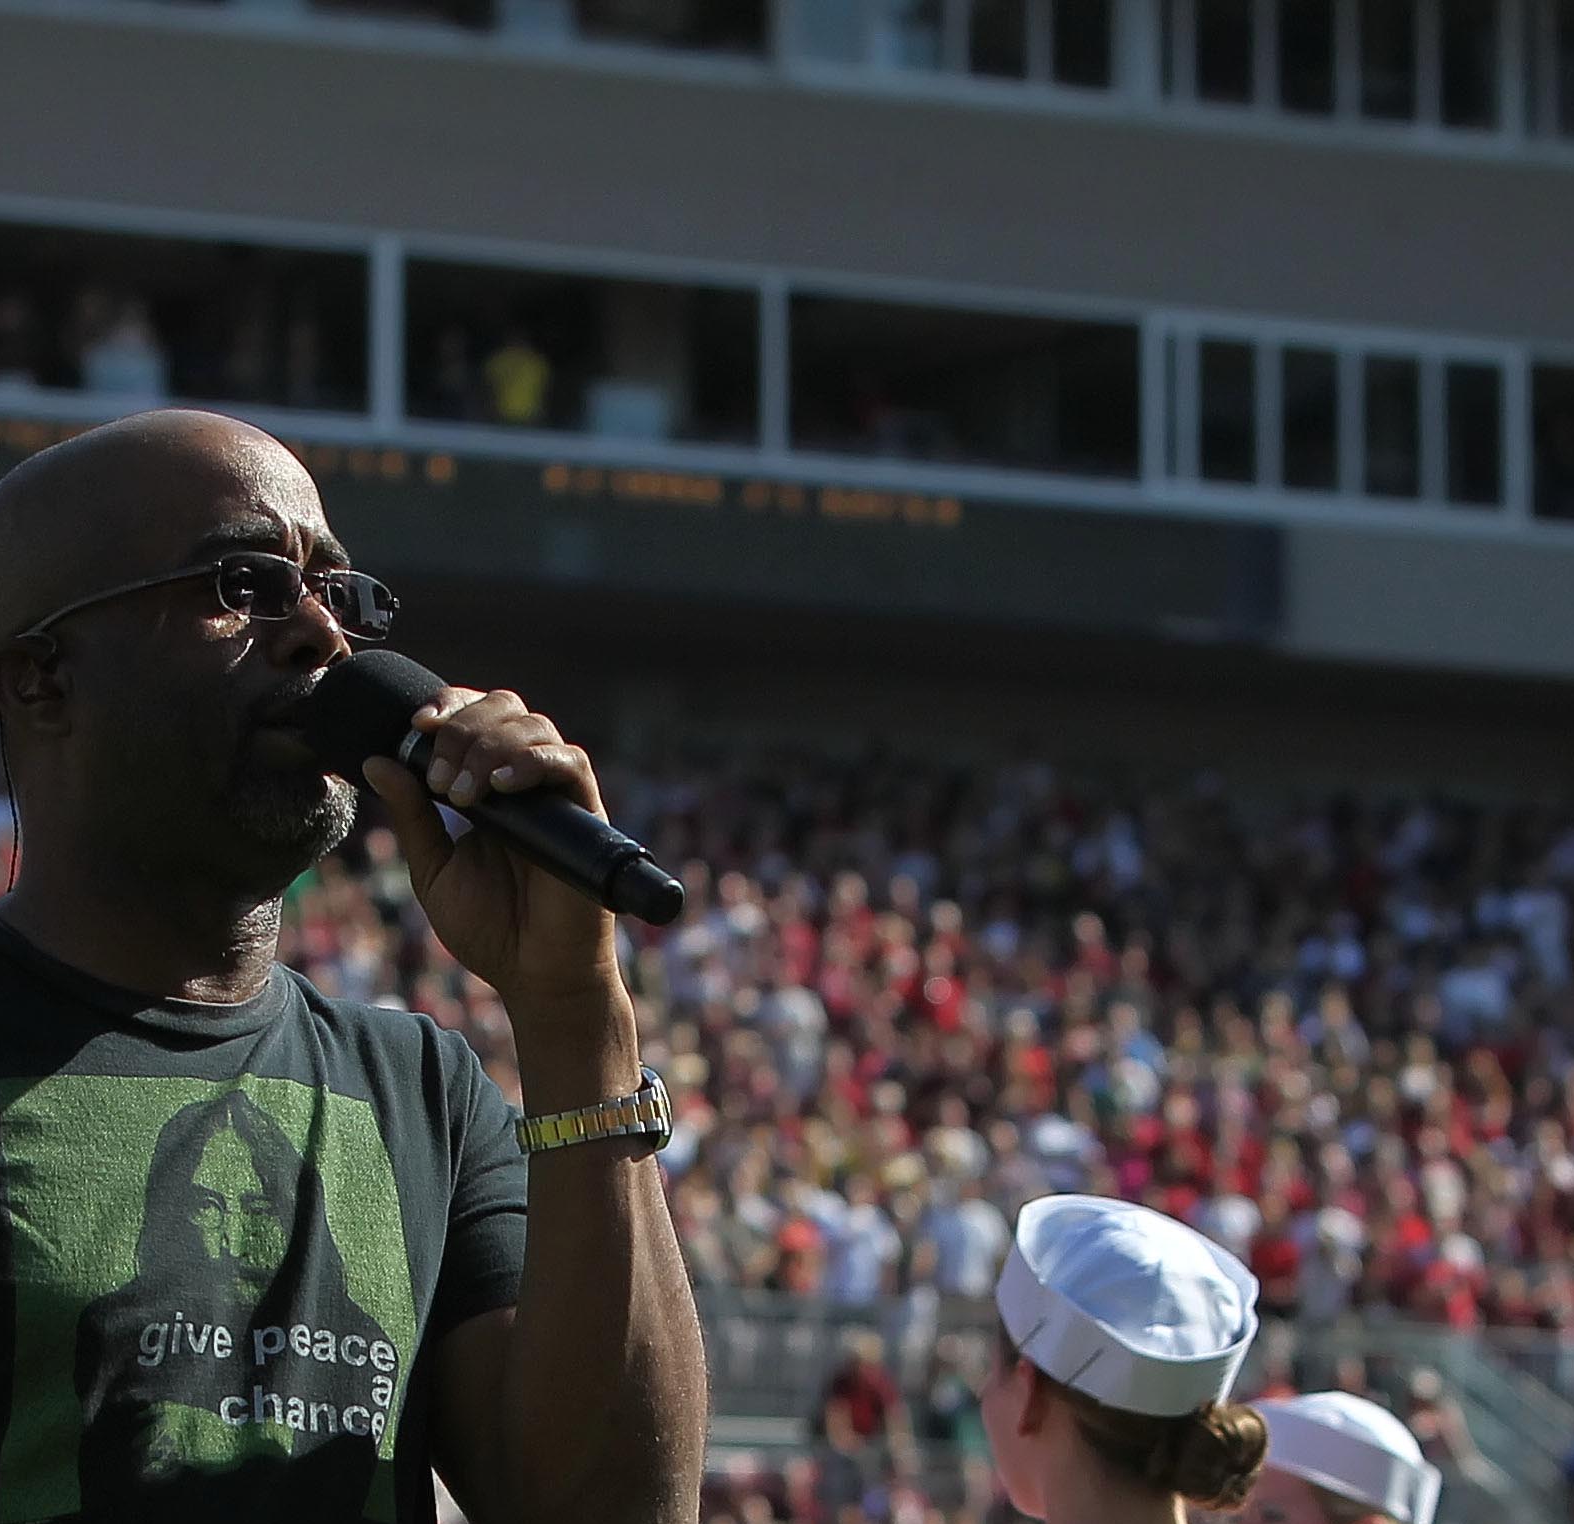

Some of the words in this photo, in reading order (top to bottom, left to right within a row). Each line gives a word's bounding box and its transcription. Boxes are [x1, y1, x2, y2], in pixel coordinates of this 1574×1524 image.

[137, 1311, 233, 1367] give
[252, 1323, 396, 1373] peace
[370, 1374, 394, 1410] a
